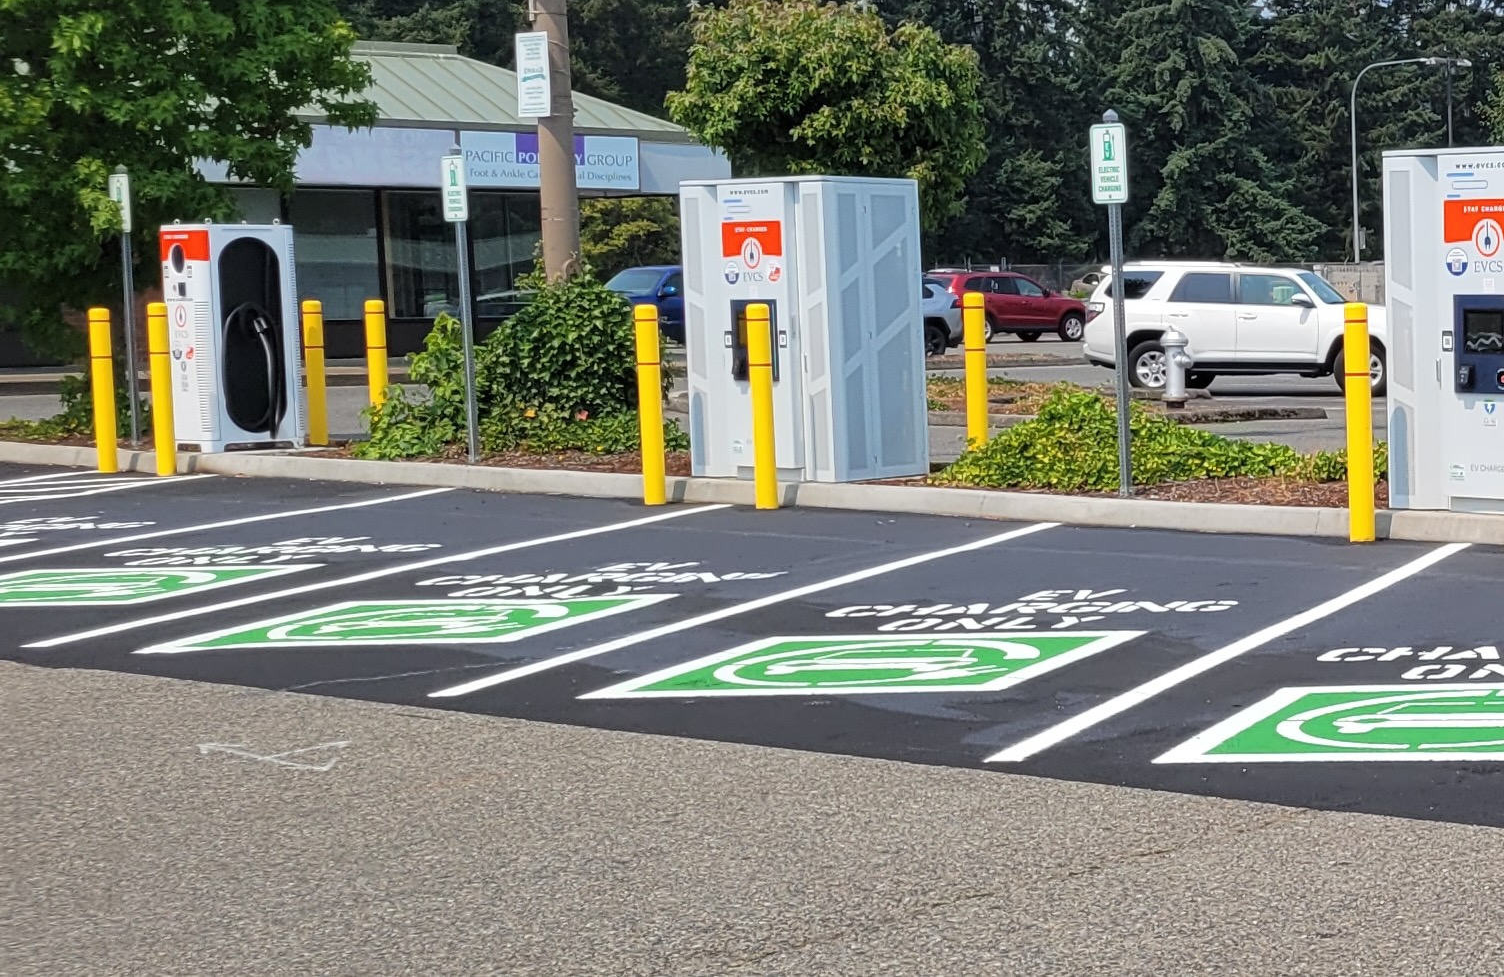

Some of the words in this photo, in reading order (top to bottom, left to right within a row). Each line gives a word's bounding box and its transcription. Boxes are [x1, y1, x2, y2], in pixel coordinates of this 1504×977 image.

[465, 150, 514, 163] PACIFIC
[587, 154, 633, 167] GROUP
[491, 170, 498, 178] &
[501, 168, 526, 178] Ankle
[587, 171, 632, 183] Disciplines
[1474, 260, 1503, 273] EVCS
[595, 562, 701, 572] EV
[1018, 588, 1129, 601] EV
[825, 600, 1240, 618] CHARGING
[877, 615, 1107, 631] ONLY
